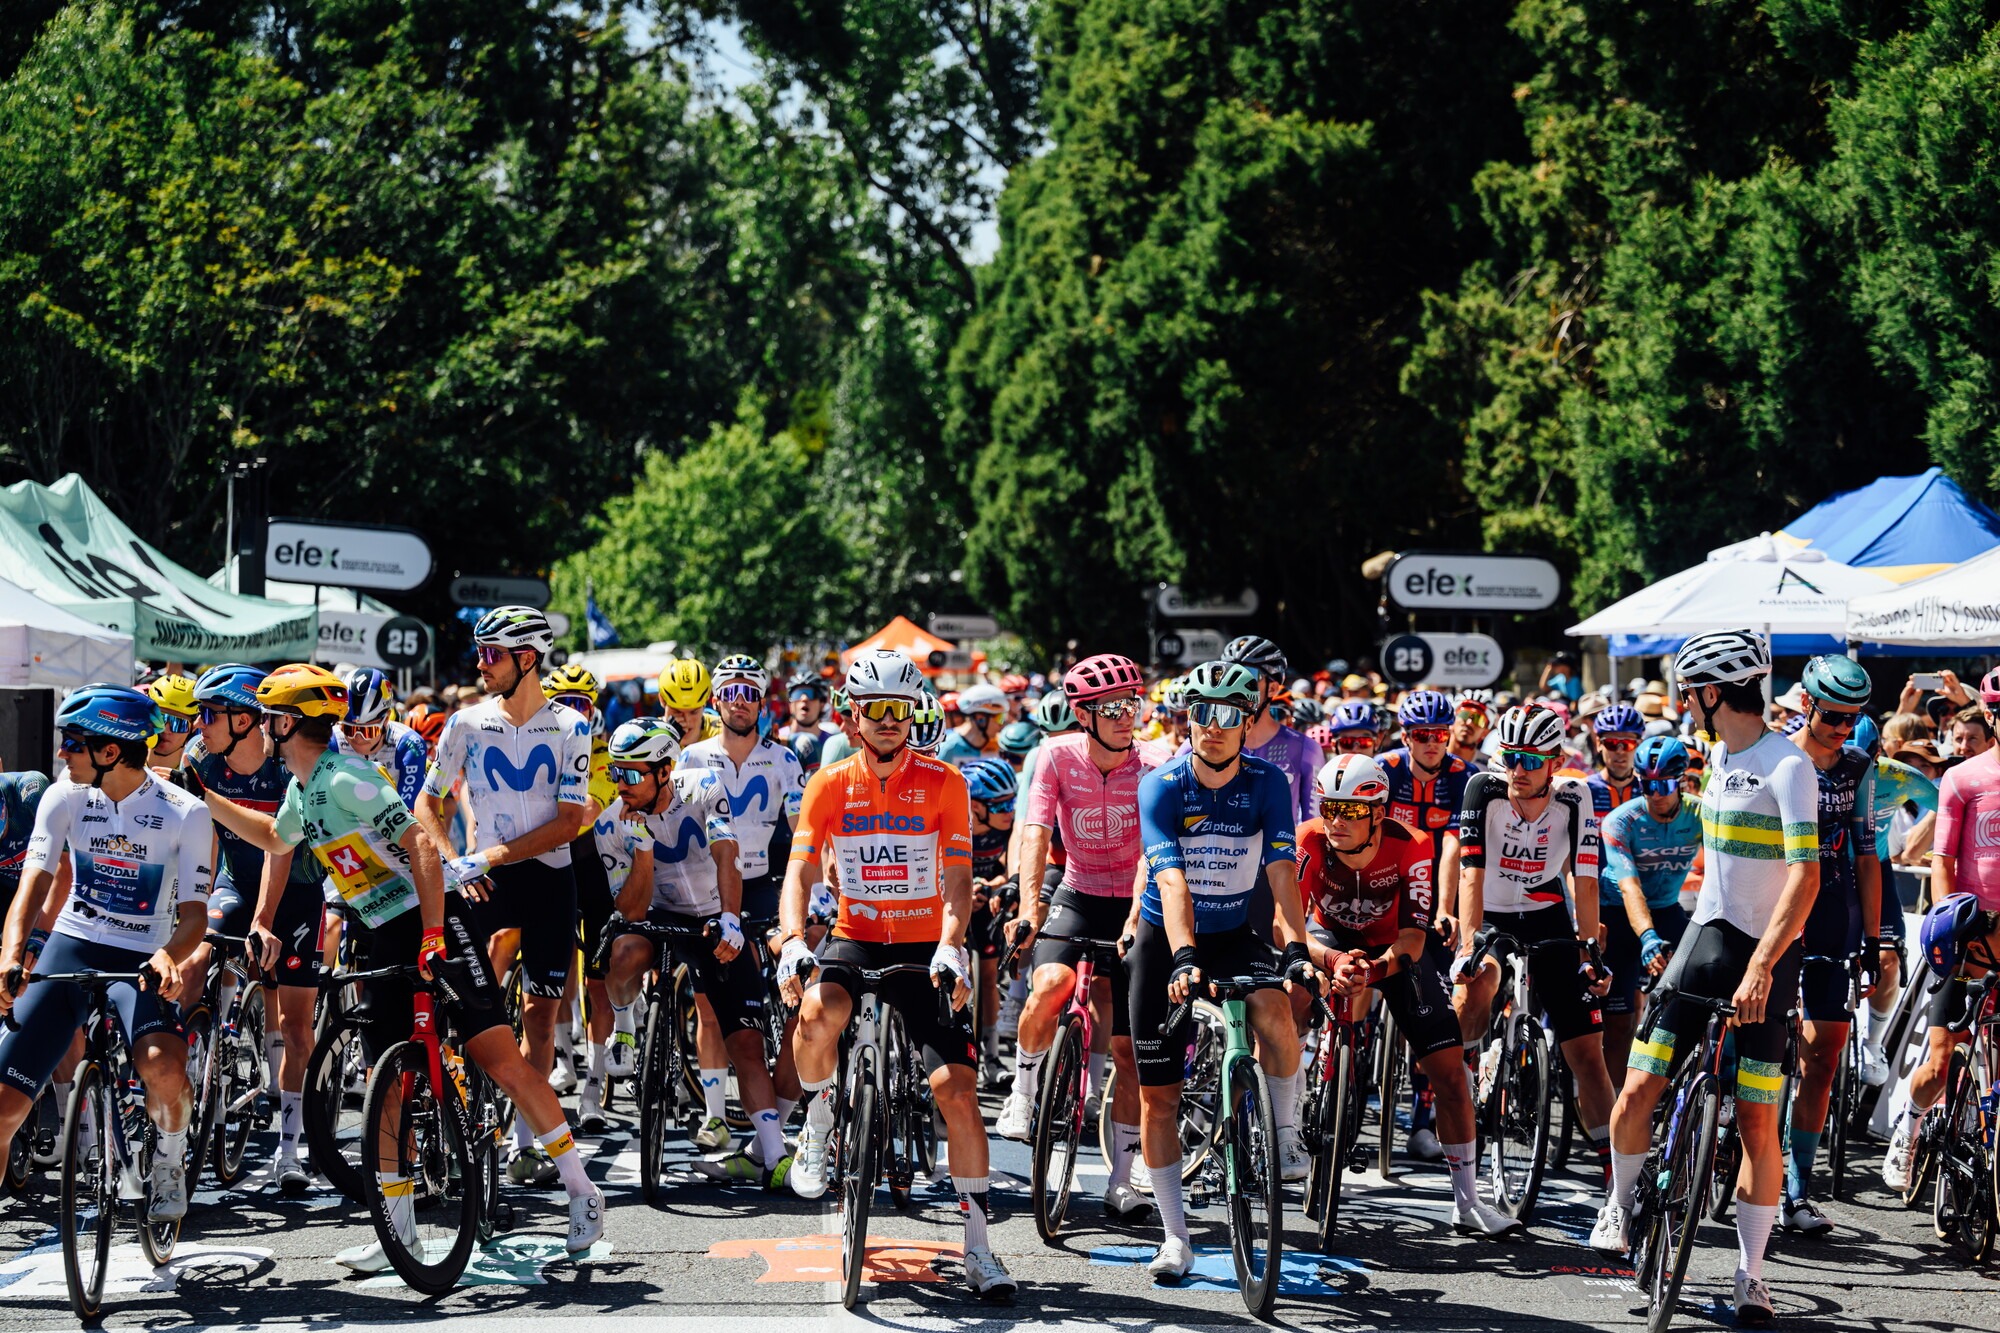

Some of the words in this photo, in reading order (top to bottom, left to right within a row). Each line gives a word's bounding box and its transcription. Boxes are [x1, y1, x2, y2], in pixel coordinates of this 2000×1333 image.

[275, 539, 340, 569] efex
[1406, 568, 1474, 597] efex
[1823, 598, 1846, 606] Hill
[1912, 596, 1948, 633] Hills
[318, 621, 366, 644] efex
[387, 629, 418, 655] 25
[1394, 647, 1424, 672] 25
[1443, 646, 1489, 666] efex
[74, 715, 140, 741] SPECIALIZED
[408, 735, 425, 756] BORA
[826, 760, 855, 776] Santos
[900, 751, 912, 773] Santos
[914, 759, 945, 773] Santos
[400, 765, 419, 801] BOSS
[1070, 784, 1092, 794] wahoo
[1818, 790, 1855, 805] HRAIN
[373, 800, 403, 827] Santini
[841, 811, 925, 833] Santos
[1200, 820, 1244, 834] Ziptrak
[90, 835, 147, 855] WHOOSH
[1076, 840, 1125, 850] Education
[1145, 840, 1177, 854] Santini
[1185, 846, 1249, 857] DECATHLON
[1502, 842, 1547, 860] UAE
[859, 845, 908, 863] UAE
[94, 862, 138, 878] SOUDAL
[865, 868, 904, 877] Emirates
[1208, 861, 1237, 870] CGM
[1203, 879, 1226, 888] RYSEL
[1369, 873, 1399, 889] caps
[1499, 871, 1543, 885] XRG
[863, 884, 909, 895] XRG
[1196, 899, 1245, 909] ADELAIDE
[880, 907, 934, 919] ADELAIDE
[98, 915, 152, 932] ADELAIDE
[448, 916, 471, 945] 1000
[463, 945, 488, 988] REMA
[1229, 1020, 1244, 1028] VR
[1427, 1038, 1456, 1050] ORBEA
[7, 1066, 38, 1090] Ekopak
[452, 1096, 470, 1137] SWISS
[558, 1138, 570, 1149] Uno
[464, 1141, 475, 1164] DT
[380, 1200, 398, 1242] SWISS
